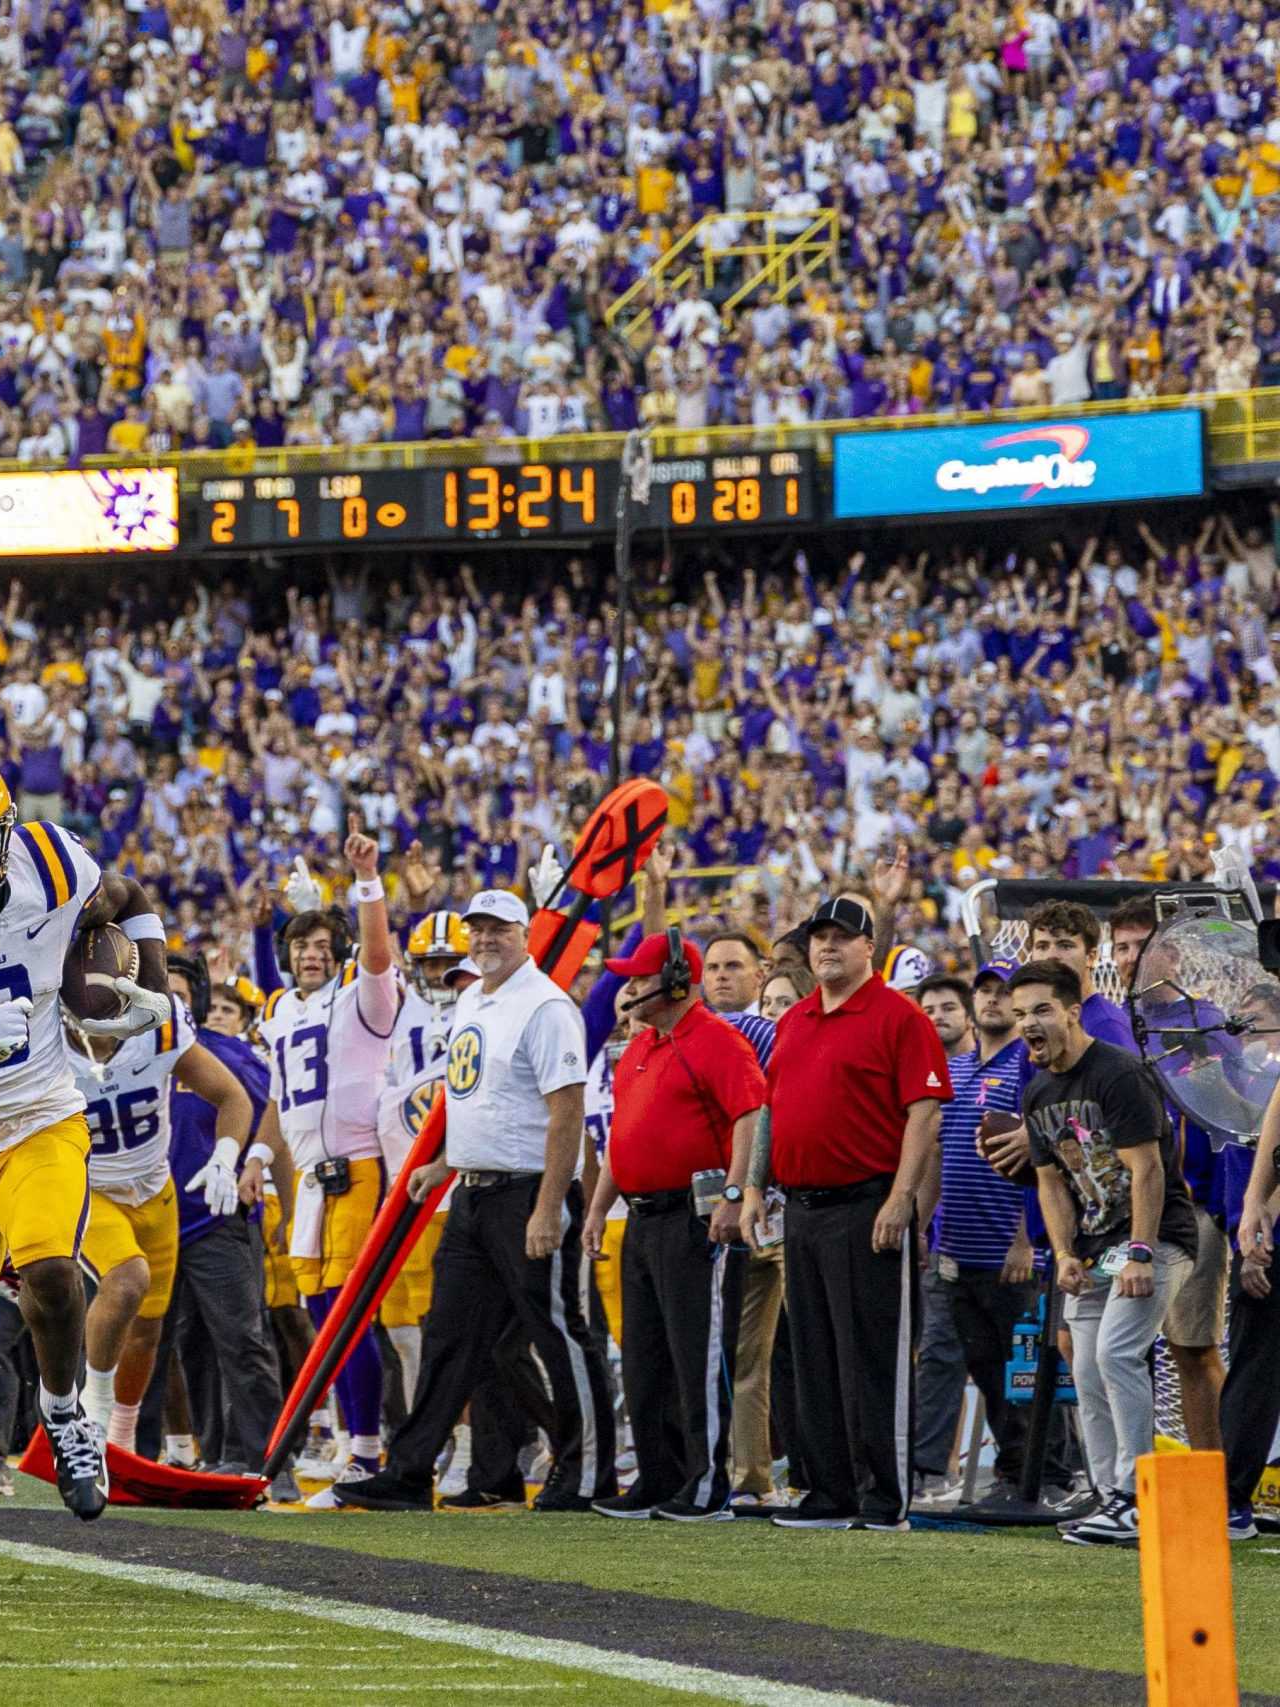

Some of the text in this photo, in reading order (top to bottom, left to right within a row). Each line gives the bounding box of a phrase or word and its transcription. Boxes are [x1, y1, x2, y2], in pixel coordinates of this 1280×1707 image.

[320, 475, 362, 499] LSU
[445, 465, 595, 529] 13:24
[671, 482, 696, 524] 0
[712, 478, 760, 521] 28
[786, 479, 798, 515] 1
[211, 501, 236, 544] 2
[277, 499, 300, 538] 7
[343, 496, 368, 538] 0
[275, 1023, 329, 1113] 13
[447, 1029, 481, 1090] SEC
